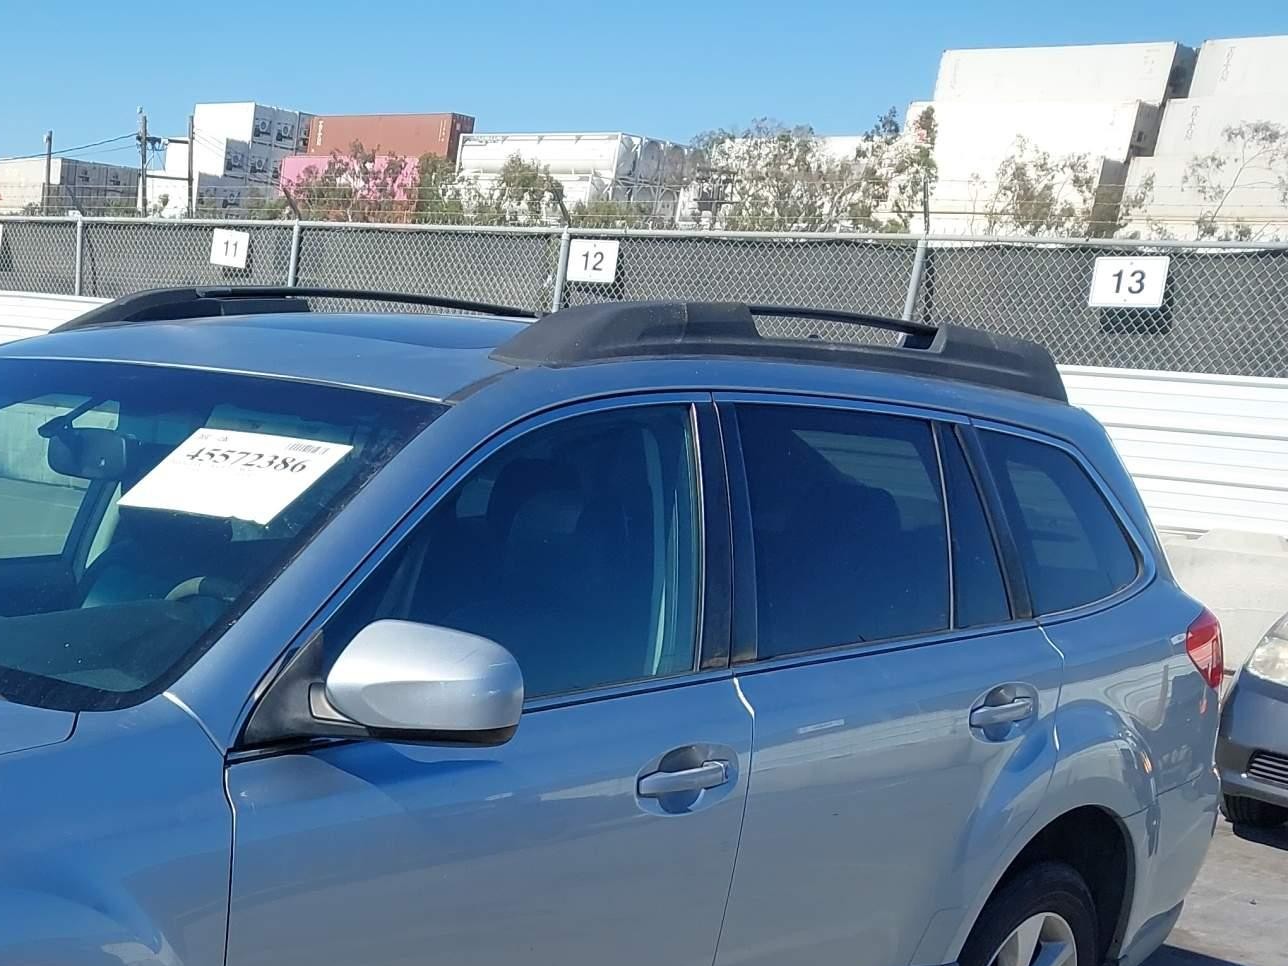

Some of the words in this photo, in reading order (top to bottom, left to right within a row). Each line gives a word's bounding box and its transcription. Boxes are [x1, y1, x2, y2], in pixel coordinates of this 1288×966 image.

[223, 240, 238, 257] 11
[581, 250, 604, 271] 12
[1112, 269, 1146, 294] 13
[186, 447, 312, 473] 45572386
